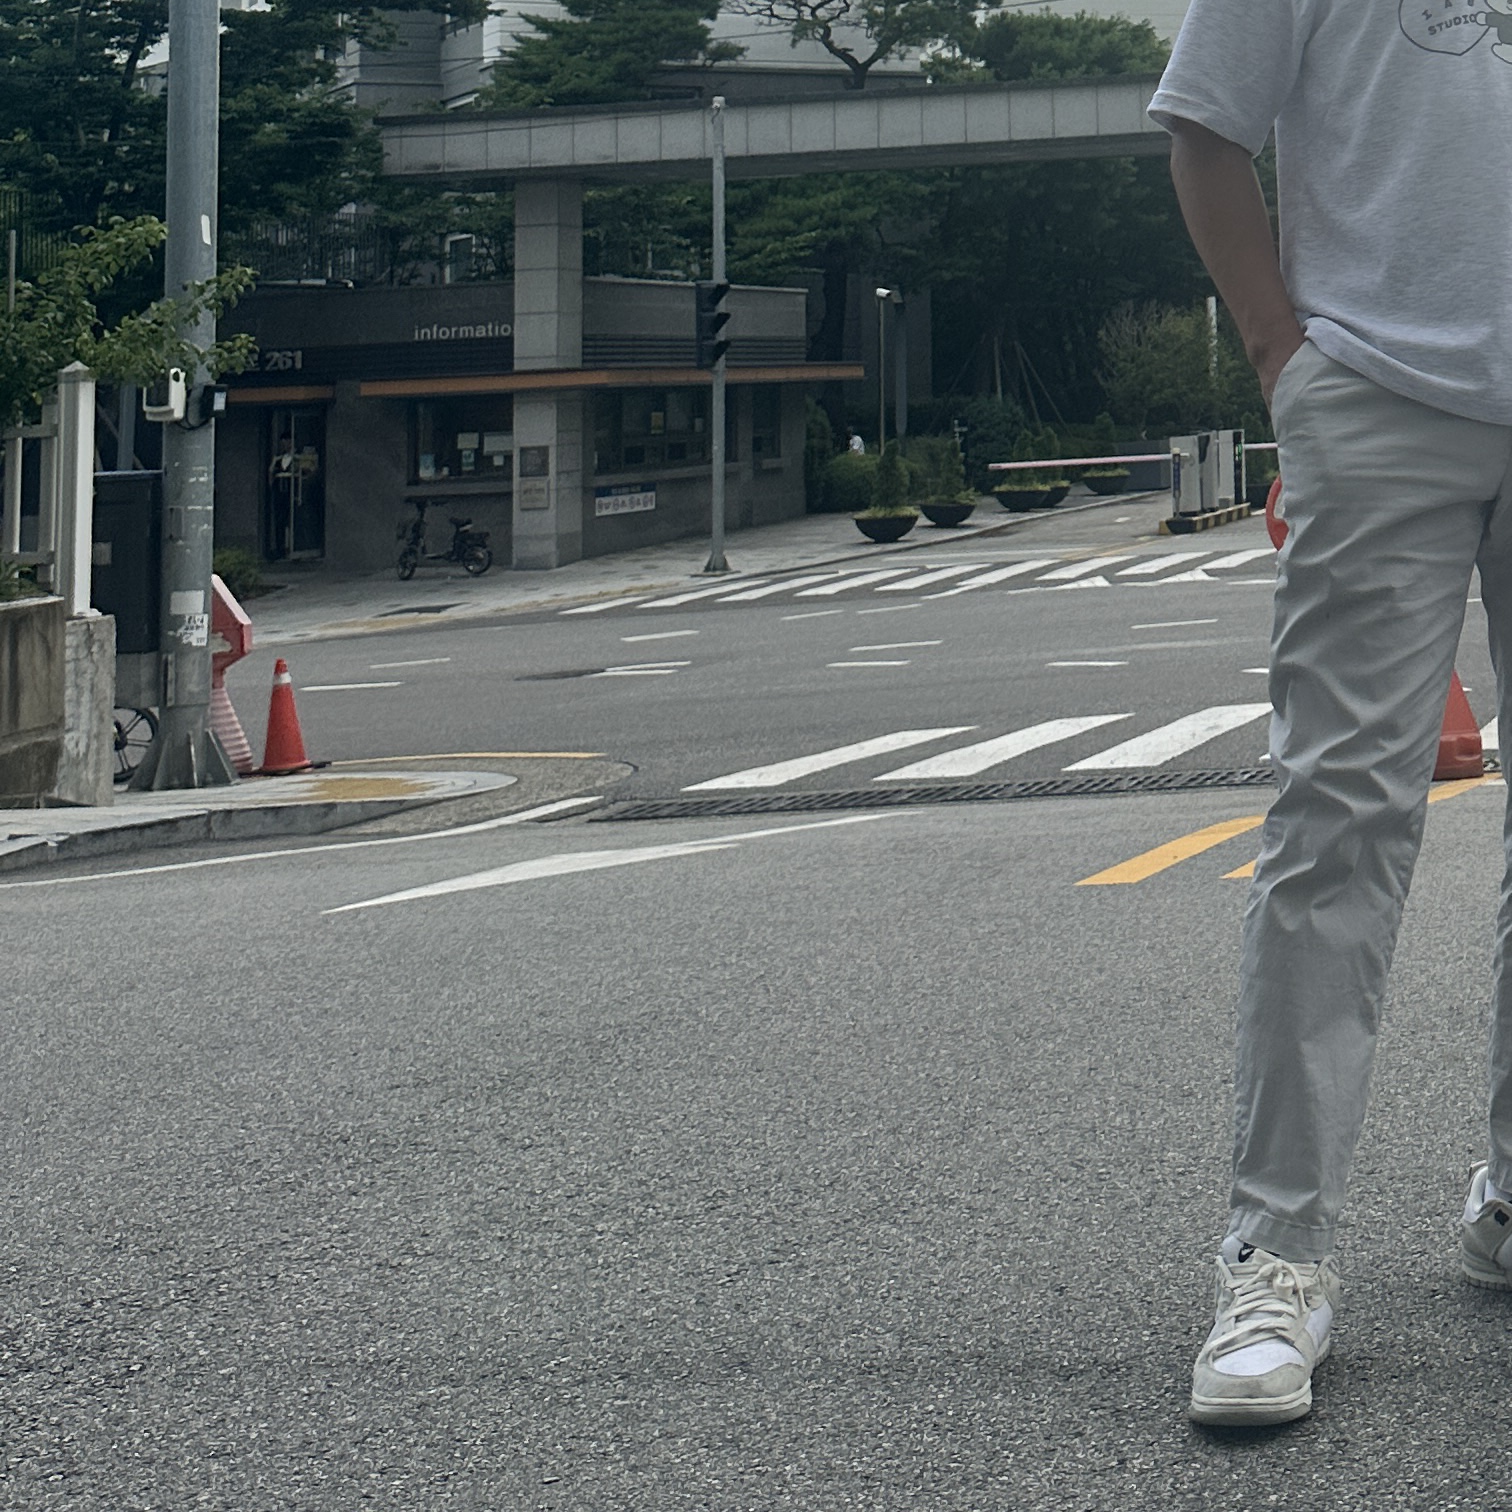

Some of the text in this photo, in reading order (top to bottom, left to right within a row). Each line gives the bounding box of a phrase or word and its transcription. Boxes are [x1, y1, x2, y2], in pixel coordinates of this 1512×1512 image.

[1427, 13, 1477, 35] STUDIO
[414, 321, 513, 341] informatio
[265, 350, 303, 371] 261
